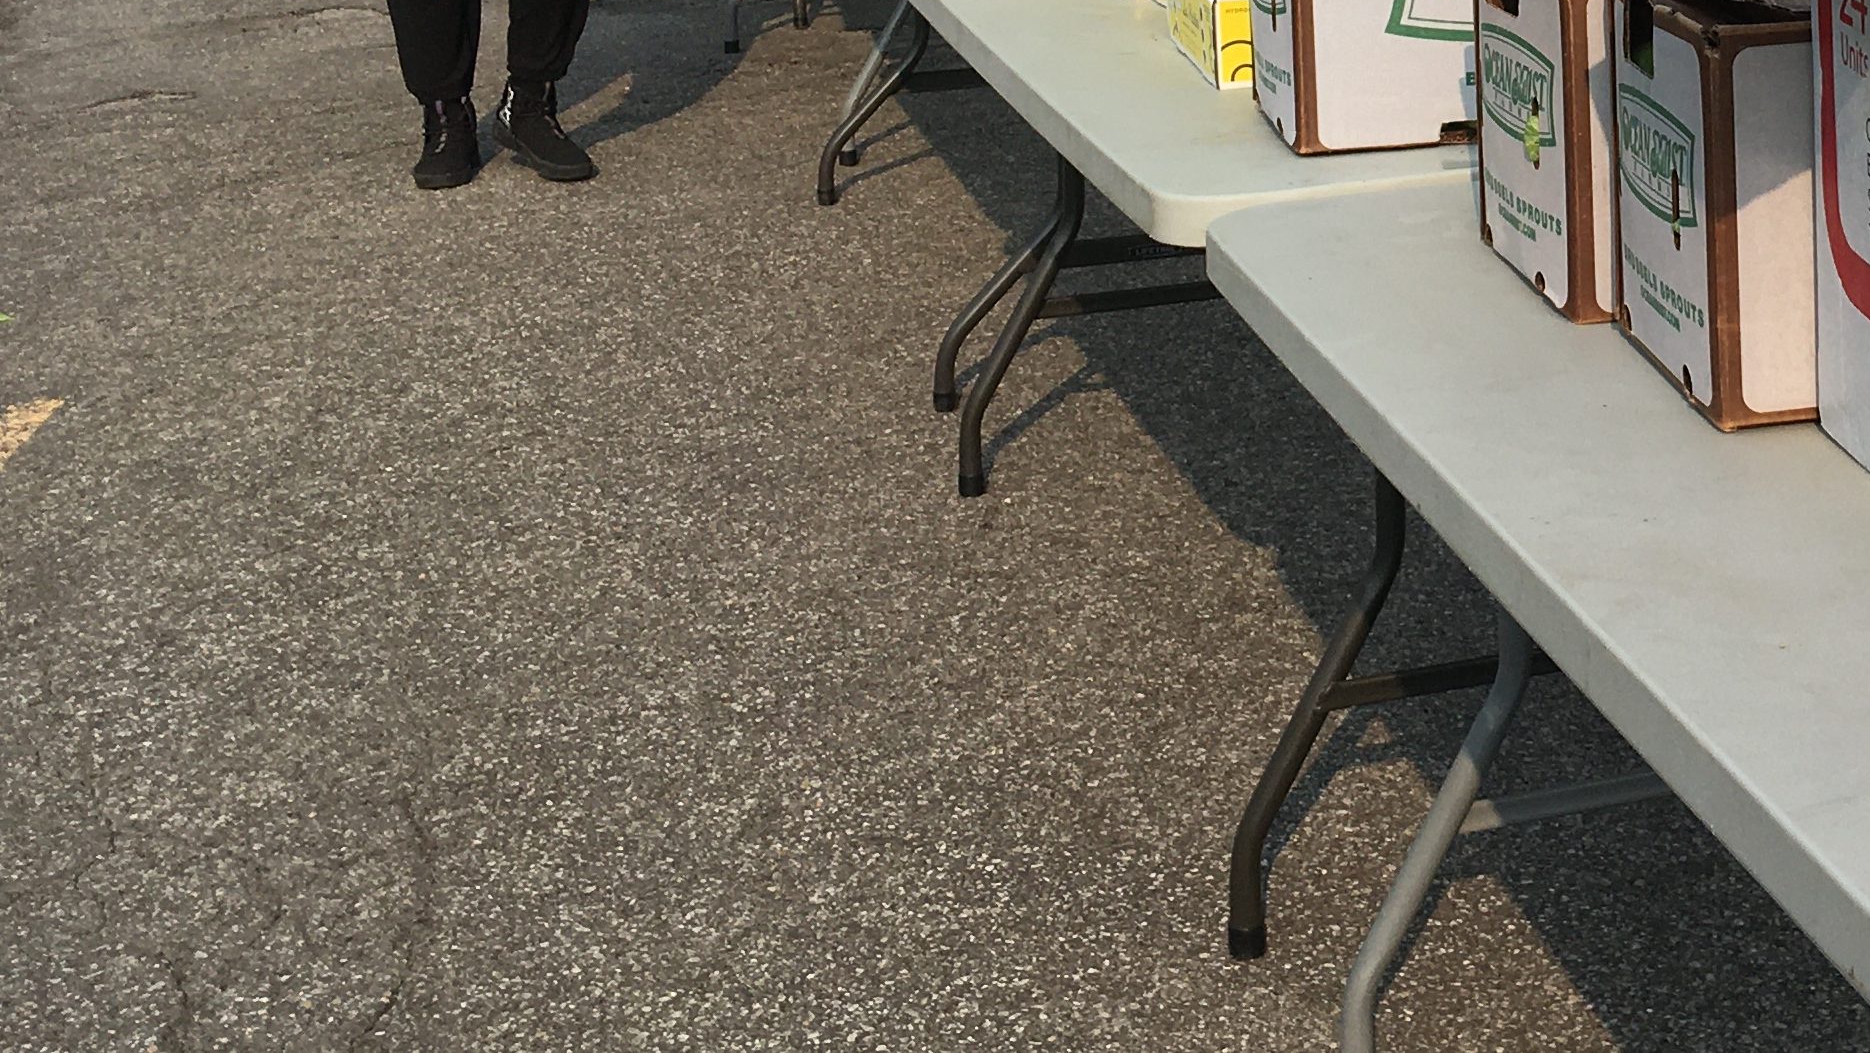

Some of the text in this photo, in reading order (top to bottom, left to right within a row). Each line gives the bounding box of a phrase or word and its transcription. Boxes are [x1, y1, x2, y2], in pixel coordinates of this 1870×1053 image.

[1840, 30, 1870, 79] Units
[1516, 196, 1563, 236] SPROUTS
[1659, 280, 1705, 328] SPROUTS
